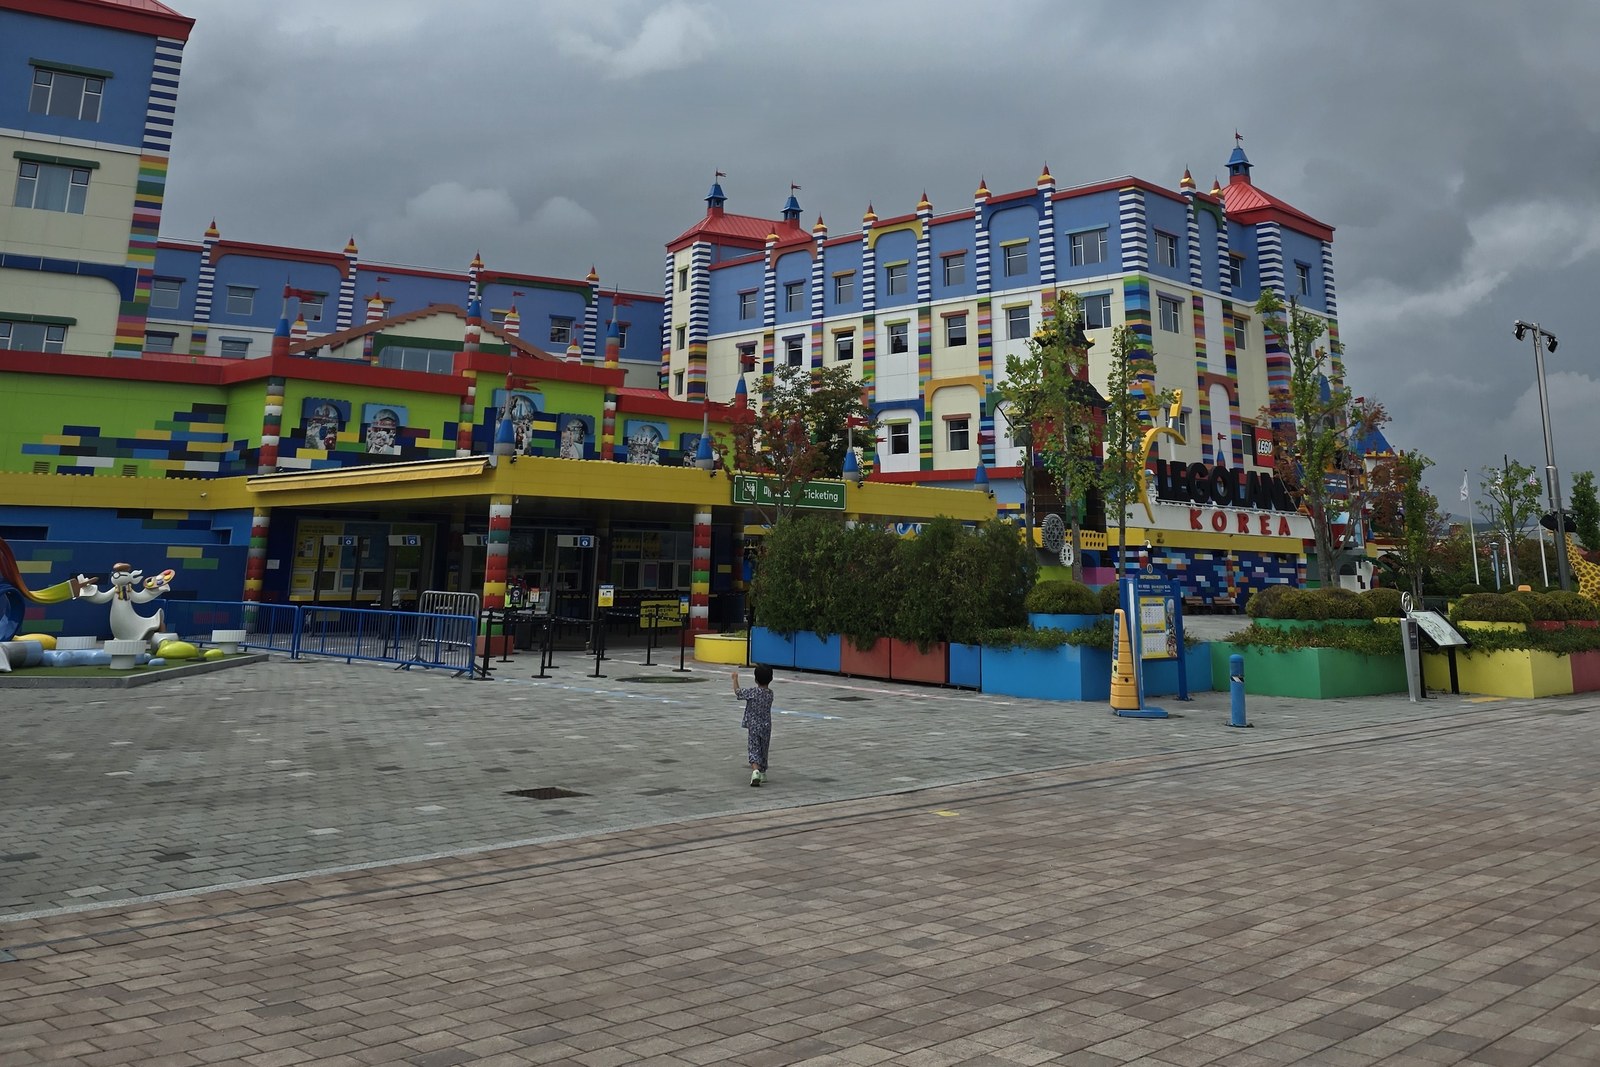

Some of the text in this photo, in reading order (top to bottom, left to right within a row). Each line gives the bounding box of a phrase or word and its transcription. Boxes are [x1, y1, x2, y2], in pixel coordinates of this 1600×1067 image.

[1257, 439, 1273, 455] LEGO
[804, 489, 838, 502] Ticketing
[1189, 509, 1291, 536] KOREA
